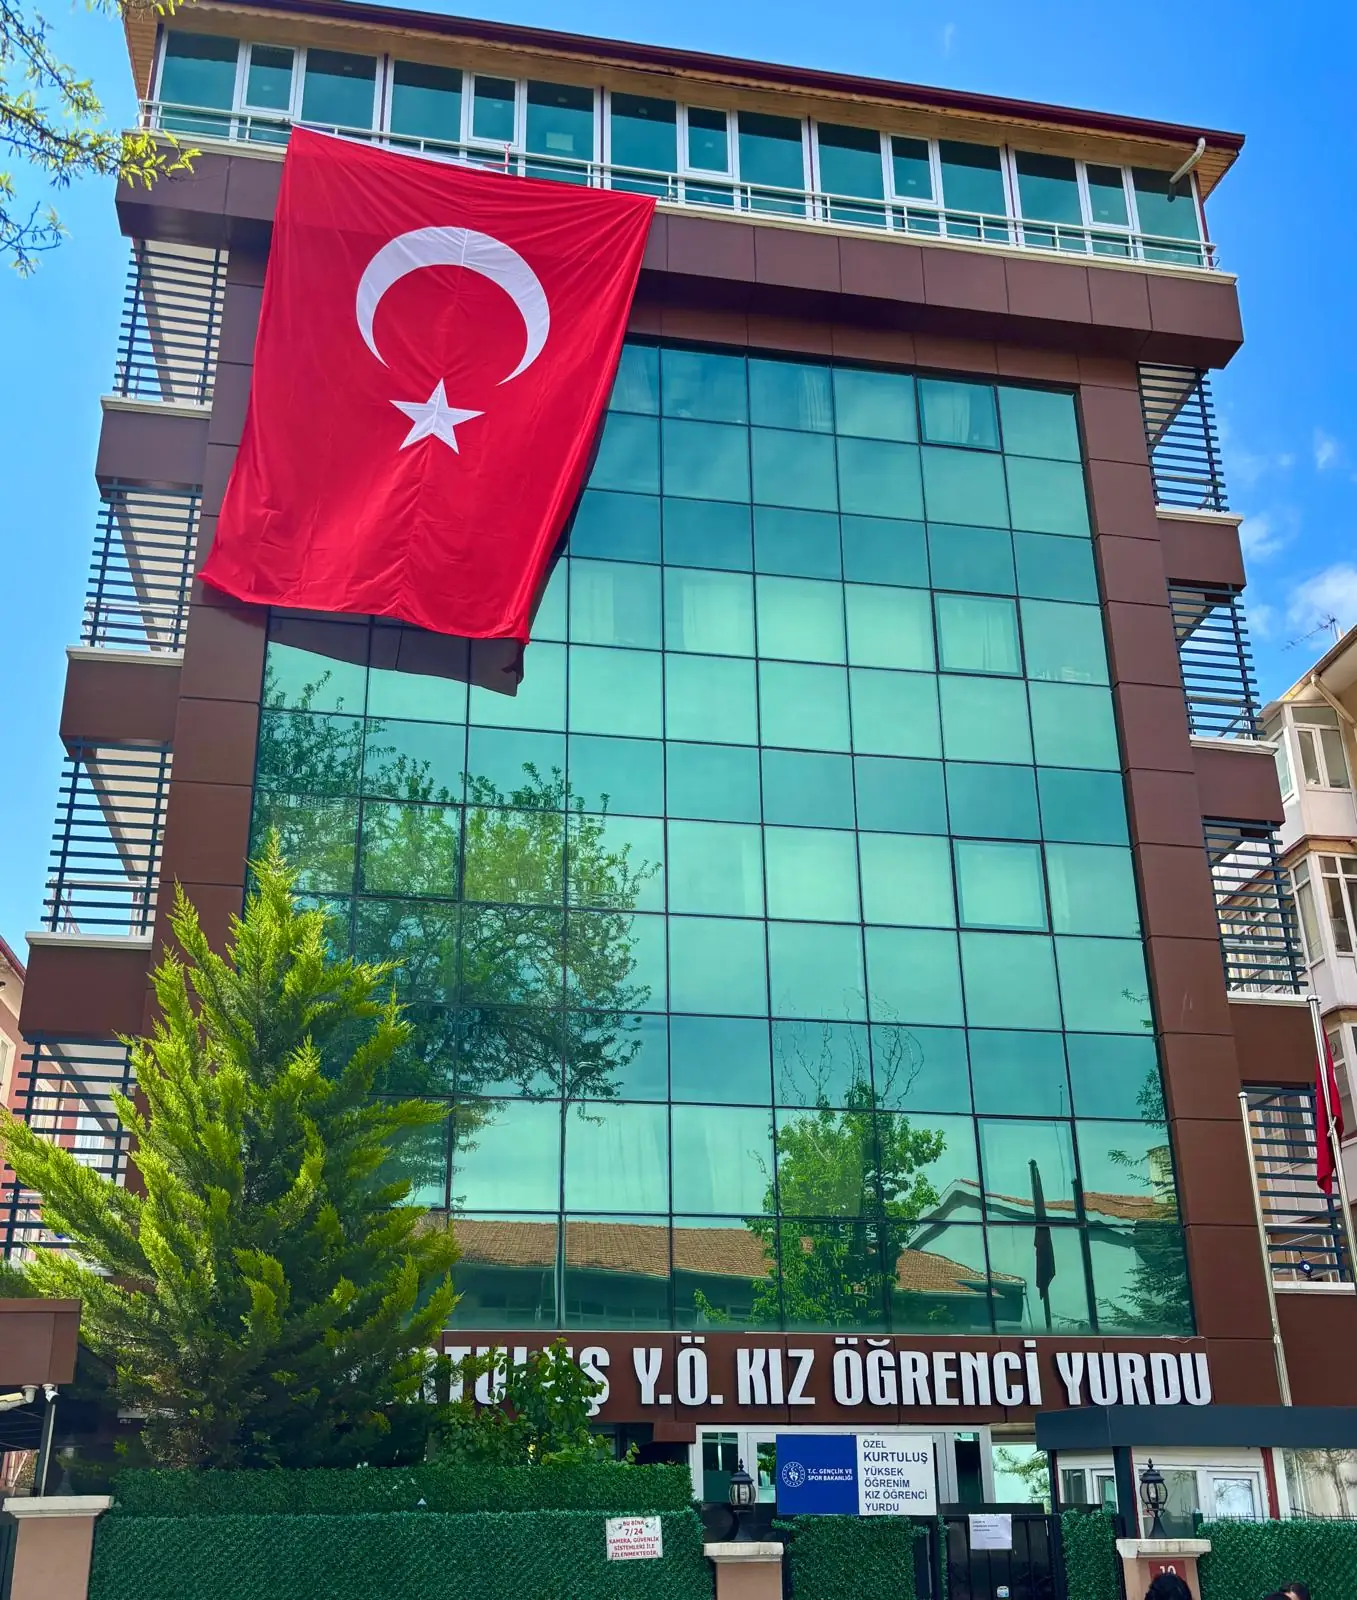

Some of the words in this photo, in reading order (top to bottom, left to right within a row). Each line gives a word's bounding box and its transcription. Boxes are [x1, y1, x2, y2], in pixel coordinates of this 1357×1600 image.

[633, 1336, 724, 1405] Y.Ö.
[737, 1348, 816, 1405] KIZ
[833, 1337, 1042, 1406] ÖĞRENCİ
[1056, 1352, 1212, 1406] YURDU
[863, 1439, 887, 1448] ÖZEL
[863, 1451, 929, 1464] KURTULUŞ
[819, 1467, 844, 1475] GENÇLİK
[863, 1465, 904, 1476] YÜKSEK
[864, 1476, 910, 1488] ÖĞRENİM
[865, 1490, 881, 1500] KIZ
[883, 1488, 928, 1500] ÖĞRENCİ
[865, 1503, 900, 1512] YURDU
[625, 1528, 643, 1536] 7/24
